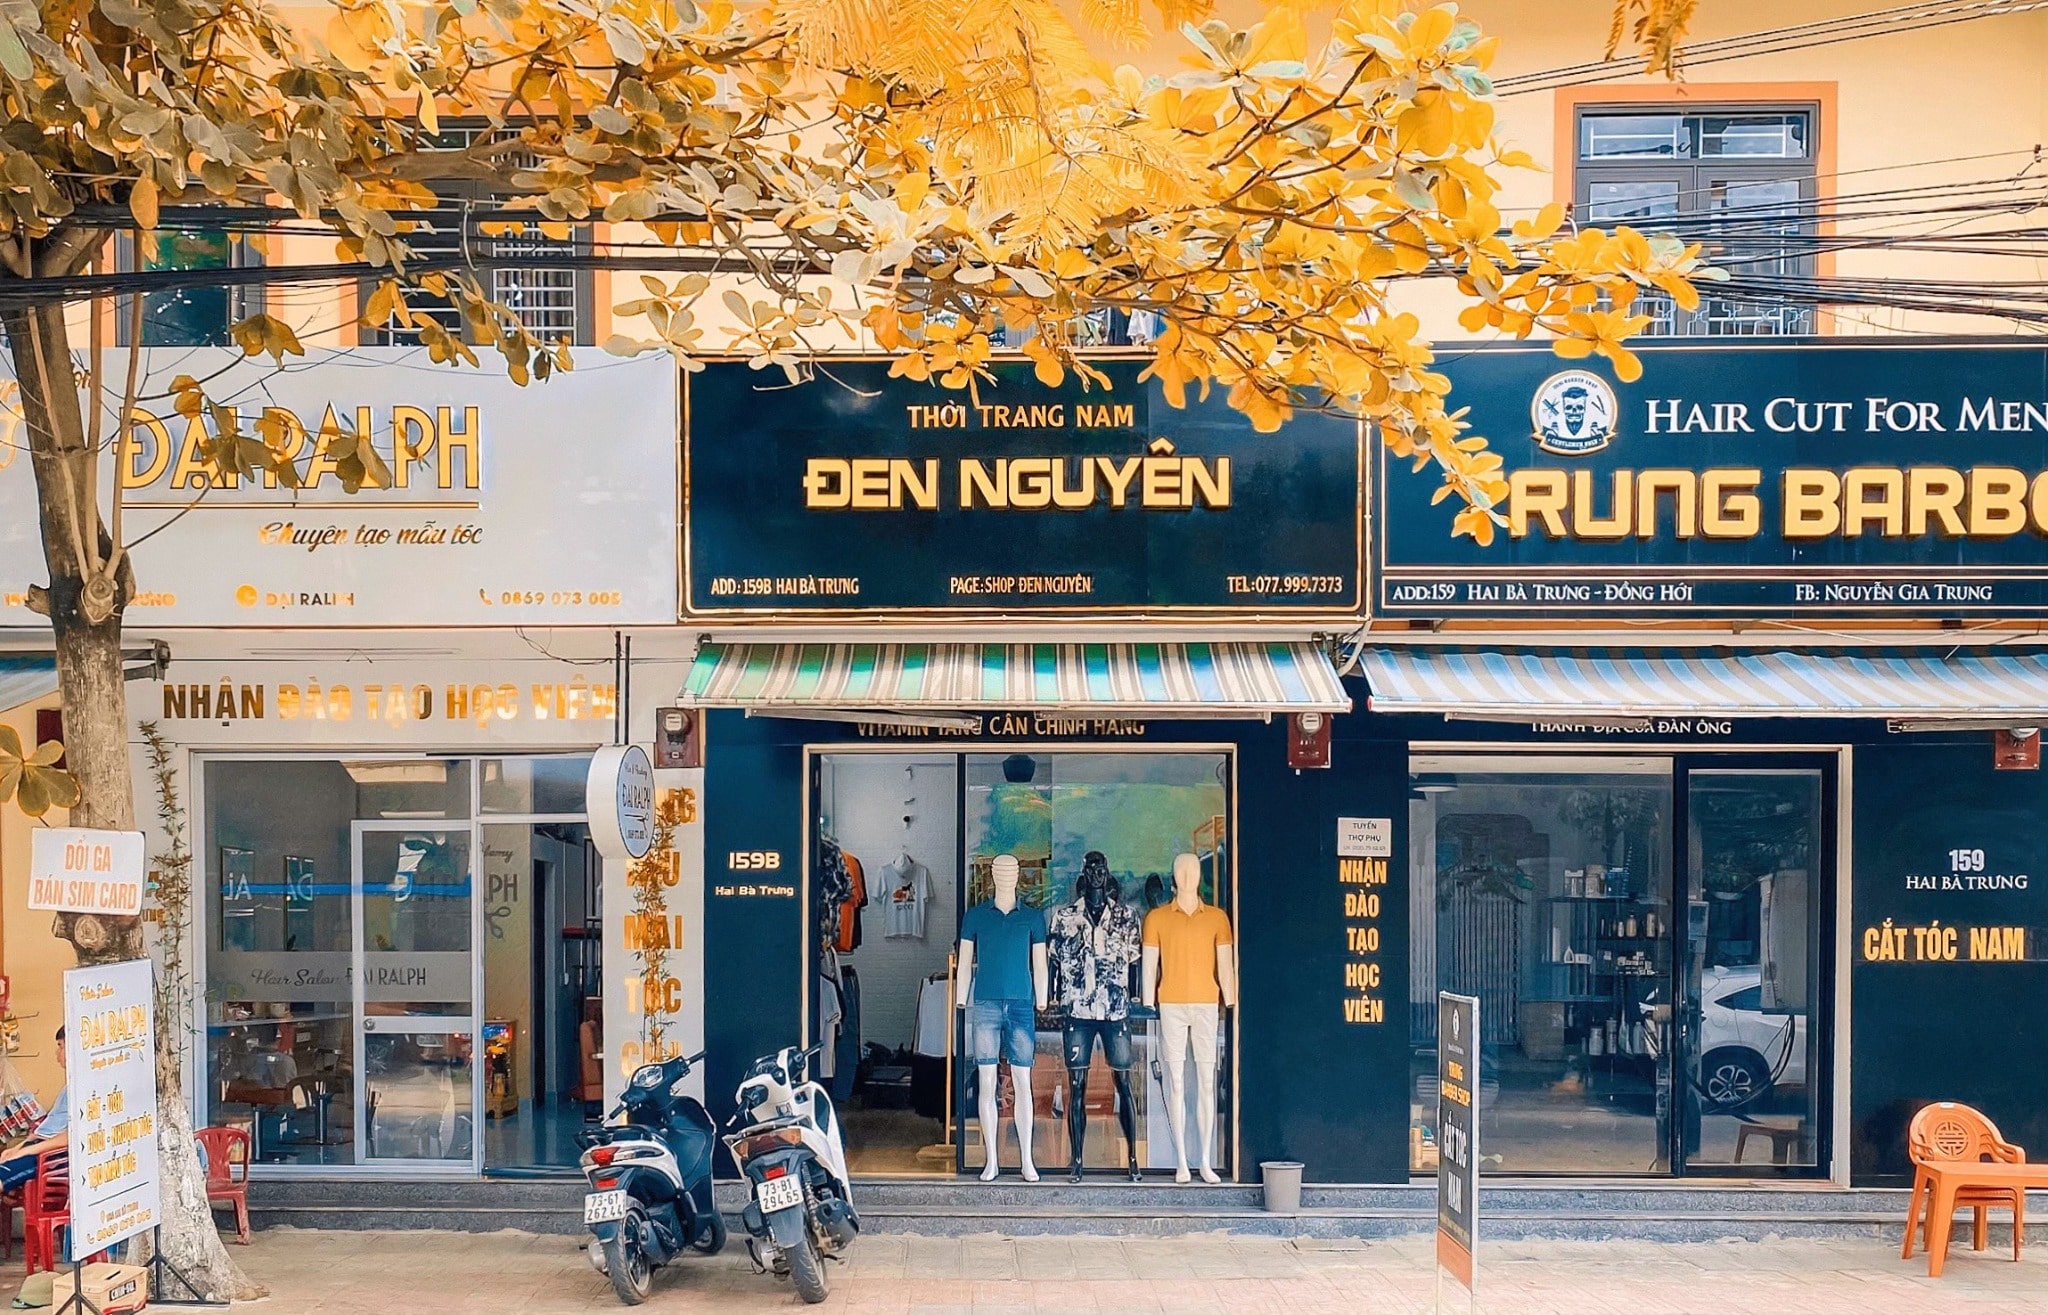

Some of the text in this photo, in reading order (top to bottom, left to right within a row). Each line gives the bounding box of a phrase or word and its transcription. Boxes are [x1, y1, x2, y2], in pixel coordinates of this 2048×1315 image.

[906, 399, 1134, 429] THỜI TRANG NAM
[1644, 398, 1754, 433] HAIR
[1764, 398, 1852, 433] CUT
[1865, 397, 1946, 433] FOR
[262, 400, 481, 490] RALPH
[802, 436, 1231, 510] ĐEN NGUYÊN
[1471, 466, 1763, 541] RUNG
[258, 520, 483, 552] Chuyên tạo mẫu tóc
[710, 575, 859, 595] ADD:159B HAI BÀ TRƯNG
[950, 574, 1091, 594] PAGE:SHOP ĐEN NGUYÊN
[1467, 584, 1500, 600] HAI
[1506, 581, 1528, 600] BÀ
[1533, 583, 1590, 600] TRƯNG
[1604, 581, 1654, 600] ĐỒNG
[1660, 582, 1693, 600] HỚI
[1795, 581, 1992, 600] FB: NGUYỄN GIA TRUNG
[501, 591, 545, 606] 0869
[551, 591, 583, 606] 073
[163, 673, 617, 729] NHẬN ĐÀO TẠO HỌC VIÊN
[989, 713, 1028, 735] CÂN
[1657, 718, 1691, 734] ĐÀN
[1696, 718, 1732, 735] ÔNG
[93, 845, 113, 872] GA
[729, 851, 781, 870] 159B
[1339, 856, 1387, 887] NHẬN
[1949, 849, 1985, 871] 159
[33, 874, 64, 905] BÁN
[68, 880, 95, 907] SIM
[99, 882, 138, 910] CARD
[715, 884, 795, 897] Hai Bà Trưng
[1906, 873, 2028, 890] HAI BÀ TRƯNG
[1345, 889, 1380, 918] ĐÀO
[1347, 927, 1379, 955] TẠO
[1864, 917, 2025, 961] CẮT TÓC NAM
[251, 968, 292, 985] Hair
[378, 967, 426, 985] RALPH
[1345, 963, 1380, 991] HỌC
[1344, 995, 1383, 1023] VIÊN
[108, 1004, 147, 1043] RALPH
